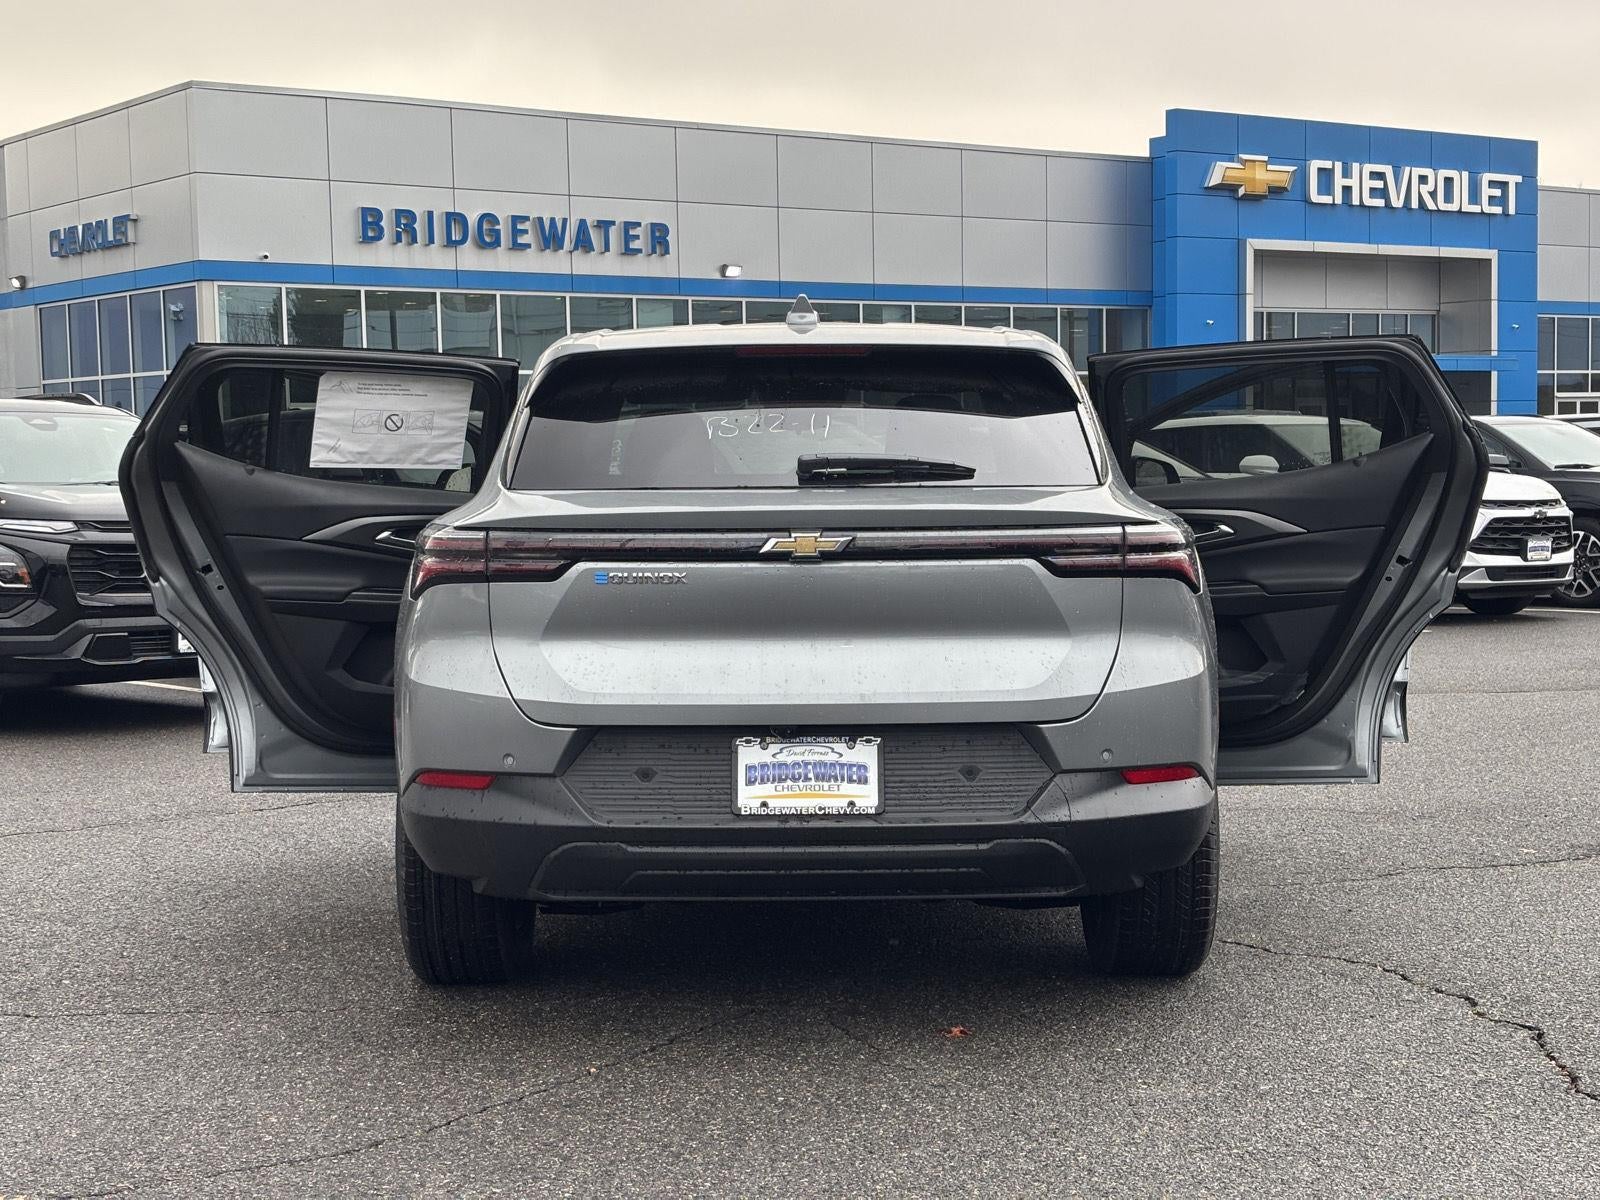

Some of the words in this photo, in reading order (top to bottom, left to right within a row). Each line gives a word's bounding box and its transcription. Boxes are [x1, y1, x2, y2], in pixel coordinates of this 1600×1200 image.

[1308, 159, 1522, 215] CHEVROLET
[49, 213, 138, 257] CHEVROLET
[357, 206, 671, 256] BRIDGEWATER
[594, 570, 688, 585] EQUINOX
[745, 760, 870, 786] BRIDGEWATER
[774, 784, 842, 792] CHEVROLET
